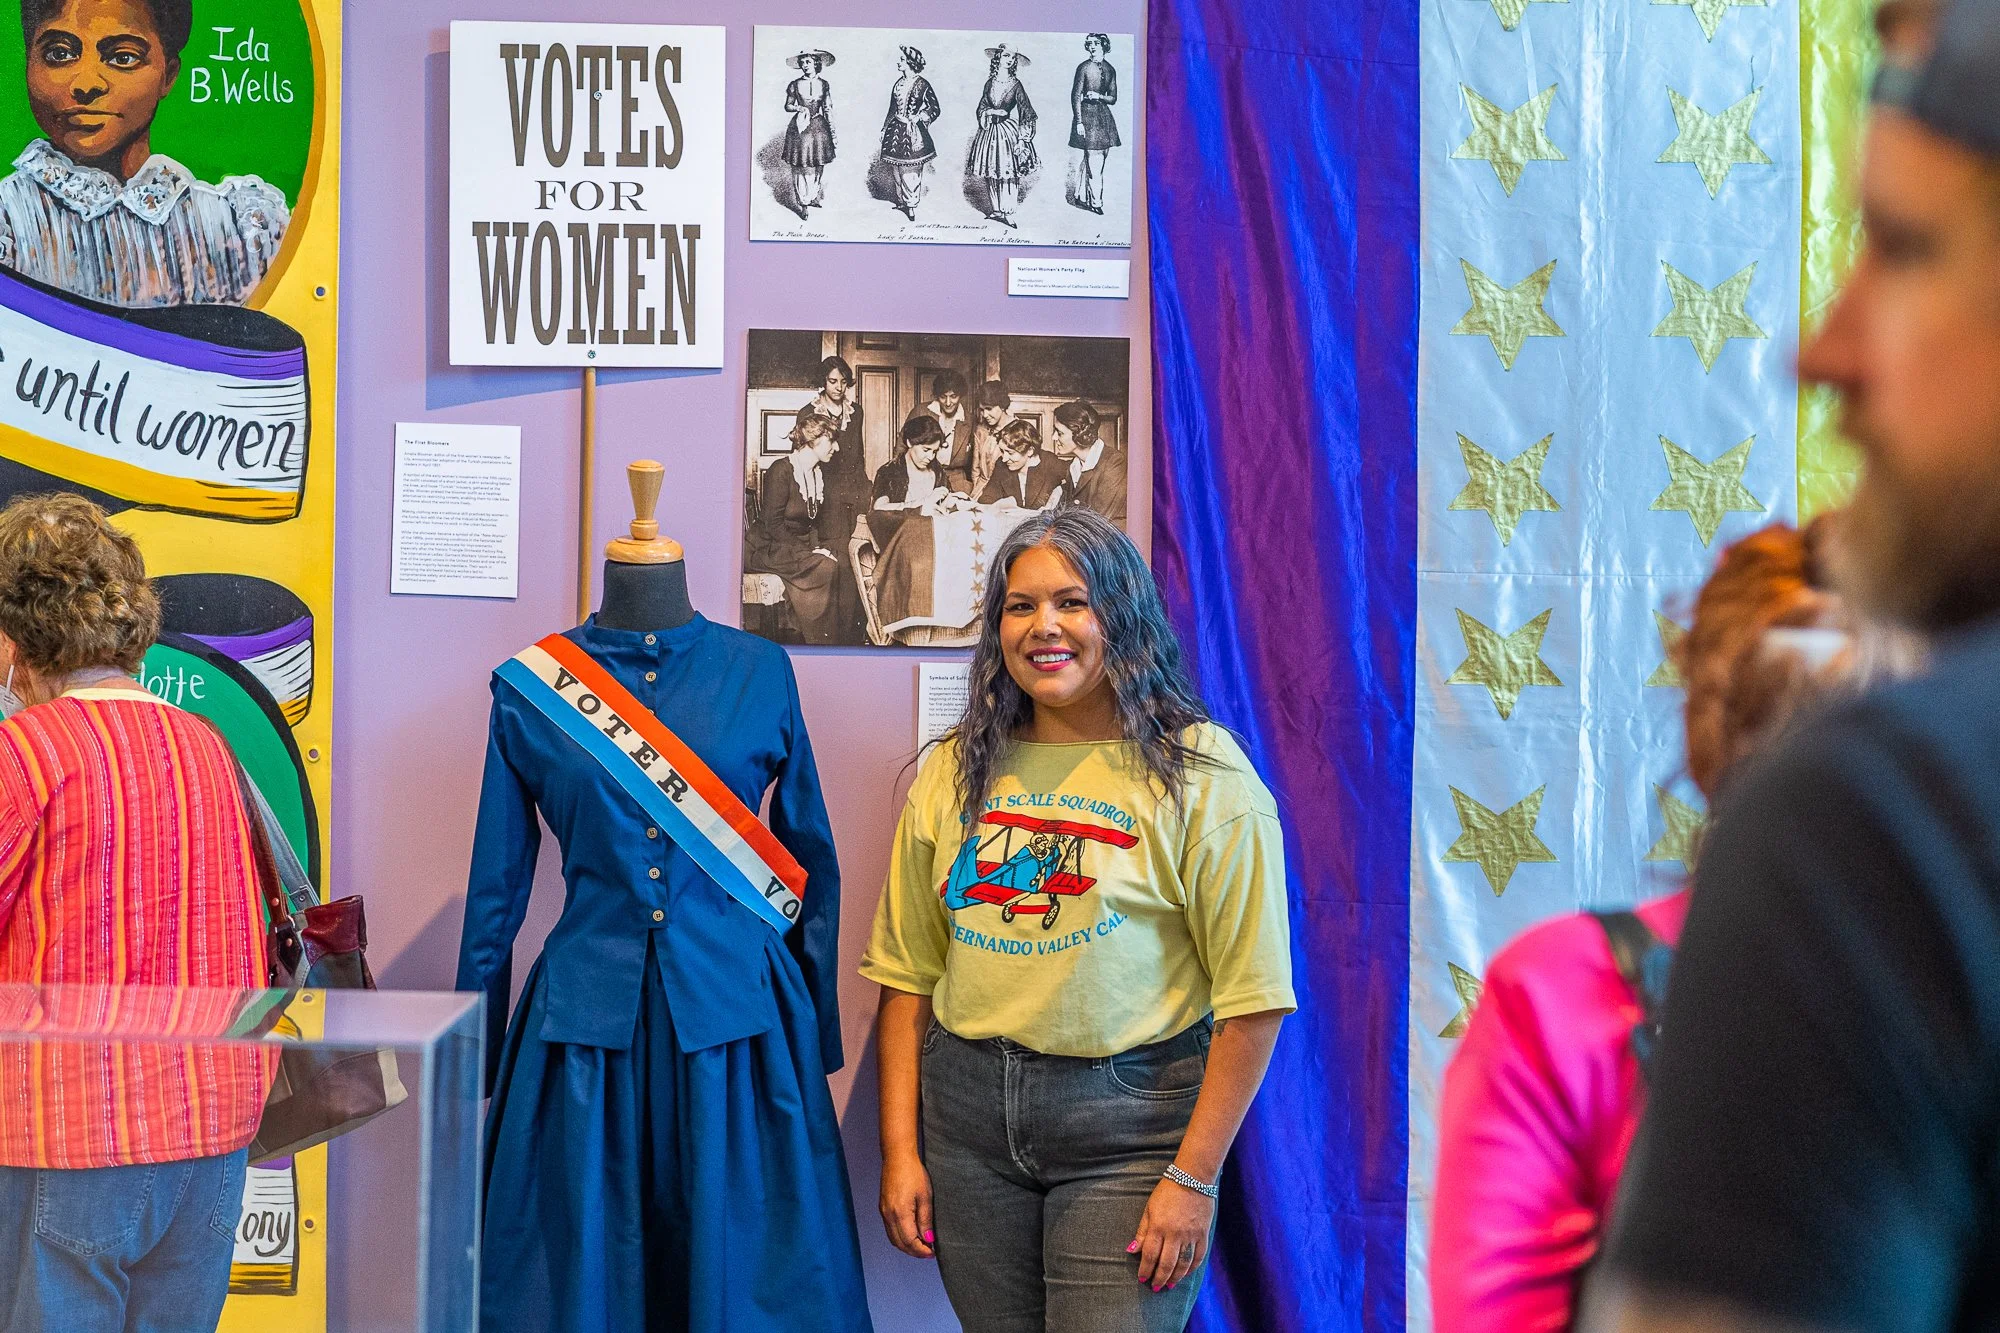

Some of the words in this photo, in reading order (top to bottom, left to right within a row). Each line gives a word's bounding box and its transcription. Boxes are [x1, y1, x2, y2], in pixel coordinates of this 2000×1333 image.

[209, 26, 270, 62] Ida
[501, 43, 684, 168] VOTES
[535, 180, 647, 211] FOR
[473, 220, 701, 347] WOMEN
[16, 357, 122, 444] until
[136, 404, 297, 472] women
[551, 667, 689, 803] VOTER
[1006, 793, 1056, 808] SCALE
[1058, 794, 1137, 832] SQUADRON
[953, 924, 1033, 956] ERNANDO
[1037, 927, 1091, 956] VALLEY
[1095, 912, 1129, 938] CAL.
